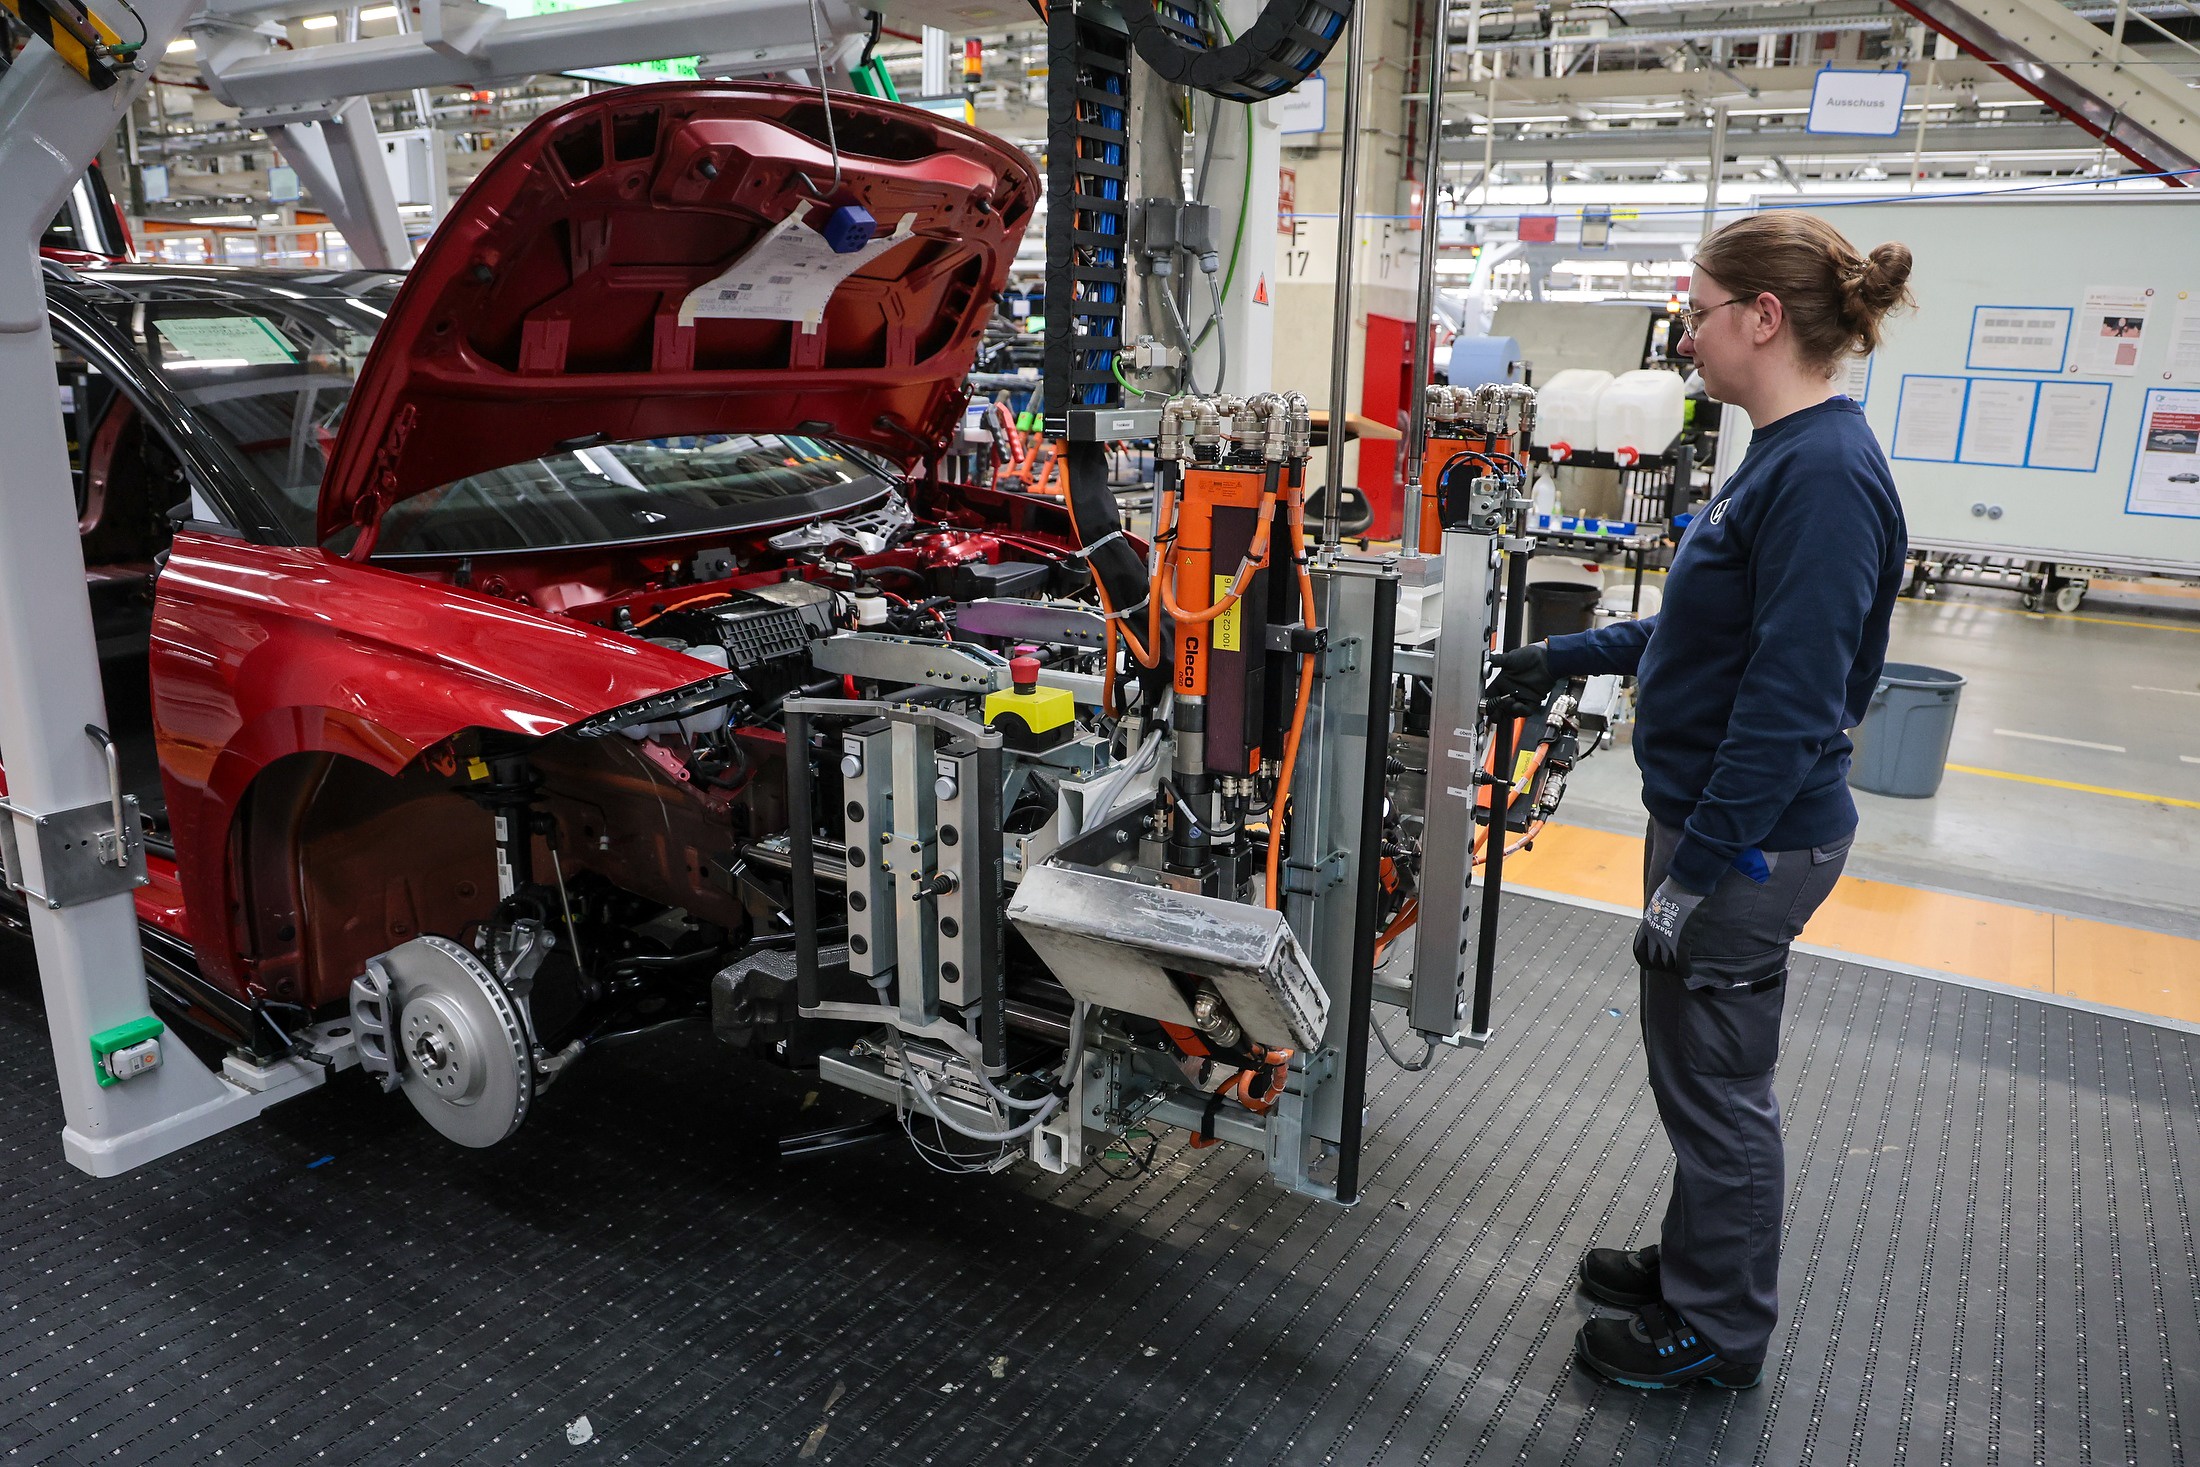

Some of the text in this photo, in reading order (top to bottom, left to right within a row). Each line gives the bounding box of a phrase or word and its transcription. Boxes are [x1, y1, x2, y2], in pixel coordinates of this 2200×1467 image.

[1826, 97, 1885, 108] Ausschuss
[1292, 221, 1307, 246] F
[1383, 223, 1391, 249] F
[1286, 251, 1310, 277] 17
[1380, 253, 1391, 279] 17
[1223, 619, 1230, 631] C2
[1185, 636, 1198, 688] Cleco
